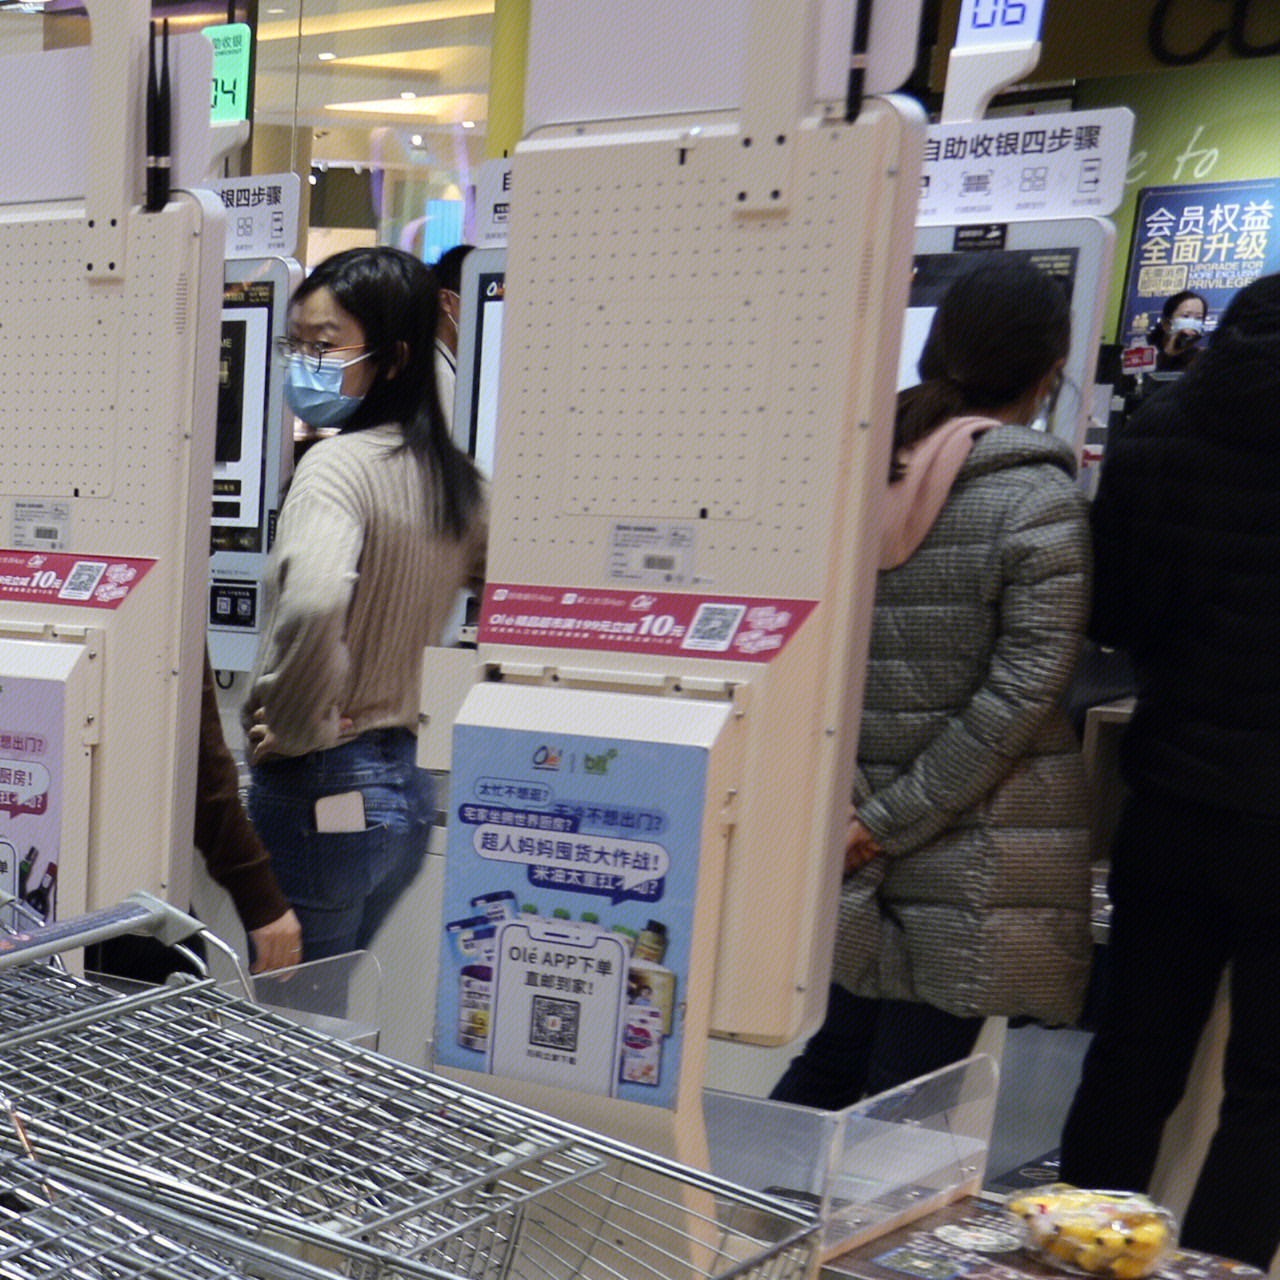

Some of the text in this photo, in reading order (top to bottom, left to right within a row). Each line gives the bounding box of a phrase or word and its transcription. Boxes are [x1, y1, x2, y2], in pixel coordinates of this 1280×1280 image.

[972, 0, 1026, 29] 06
[923, 125, 1102, 162] 自助收银四步骤
[215, 185, 282, 209] 银四步骤
[1145, 200, 1275, 238] 会员权益
[1139, 231, 1268, 265] 全面升级
[1241, 260, 1263, 270] FOR
[481, 831, 660, 872] 超人妈妈囤货大作战！
[509, 946, 614, 977] Olé APP下单
[525, 970, 595, 996] 直邮到家！
